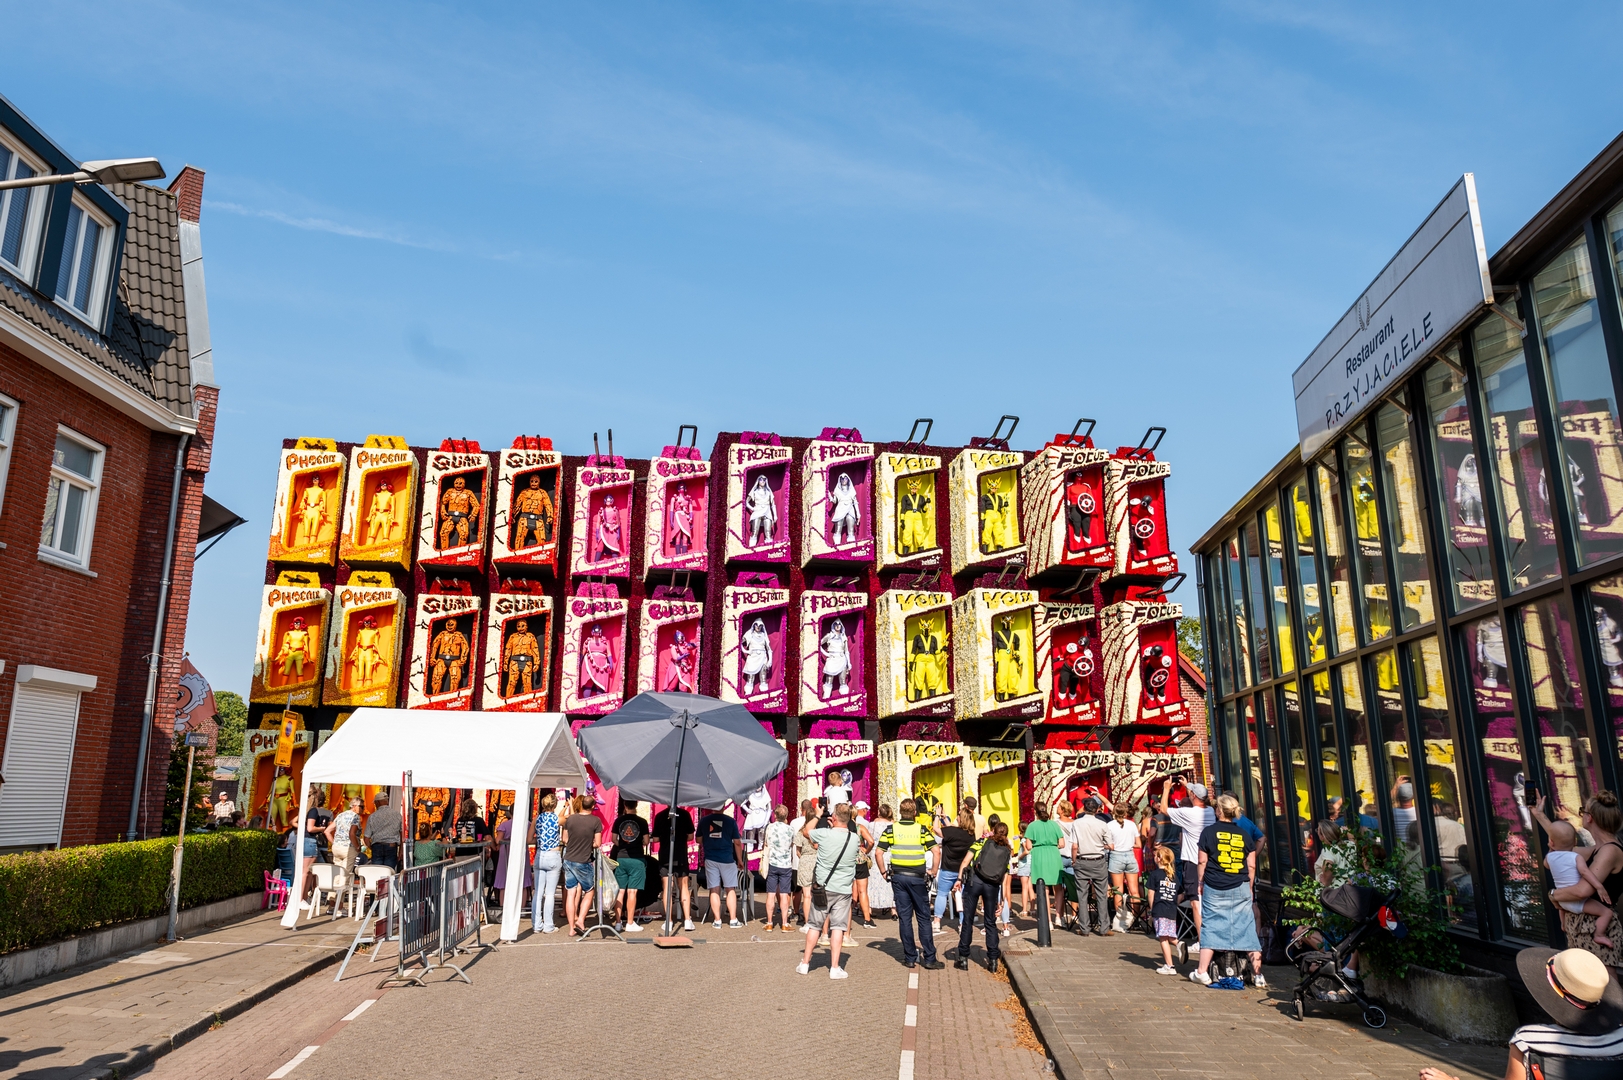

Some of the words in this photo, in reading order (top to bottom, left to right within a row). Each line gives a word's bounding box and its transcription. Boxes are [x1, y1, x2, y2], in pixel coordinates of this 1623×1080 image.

[1346, 316, 1395, 379] Restaurant
[285, 453, 336, 471] PHOENIX
[356, 451, 408, 469] PHOENIX
[737, 447, 788, 465] FROSTBITE
[820, 444, 871, 462] FROSTBITE
[1056, 451, 1105, 469] FOCUS
[1119, 463, 1167, 481] FOCUS
[268, 589, 320, 607] PHOENIX
[340, 589, 393, 608] PHOENIX
[732, 590, 784, 609] FROSTBITE
[810, 595, 862, 613] FROSTBITE
[1042, 606, 1090, 624] FOCUS
[1130, 605, 1177, 623] FOCUS
[814, 744, 868, 764] FROSTBITE
[1059, 754, 1109, 774] FOCUS
[1139, 757, 1188, 777] FOCUS
